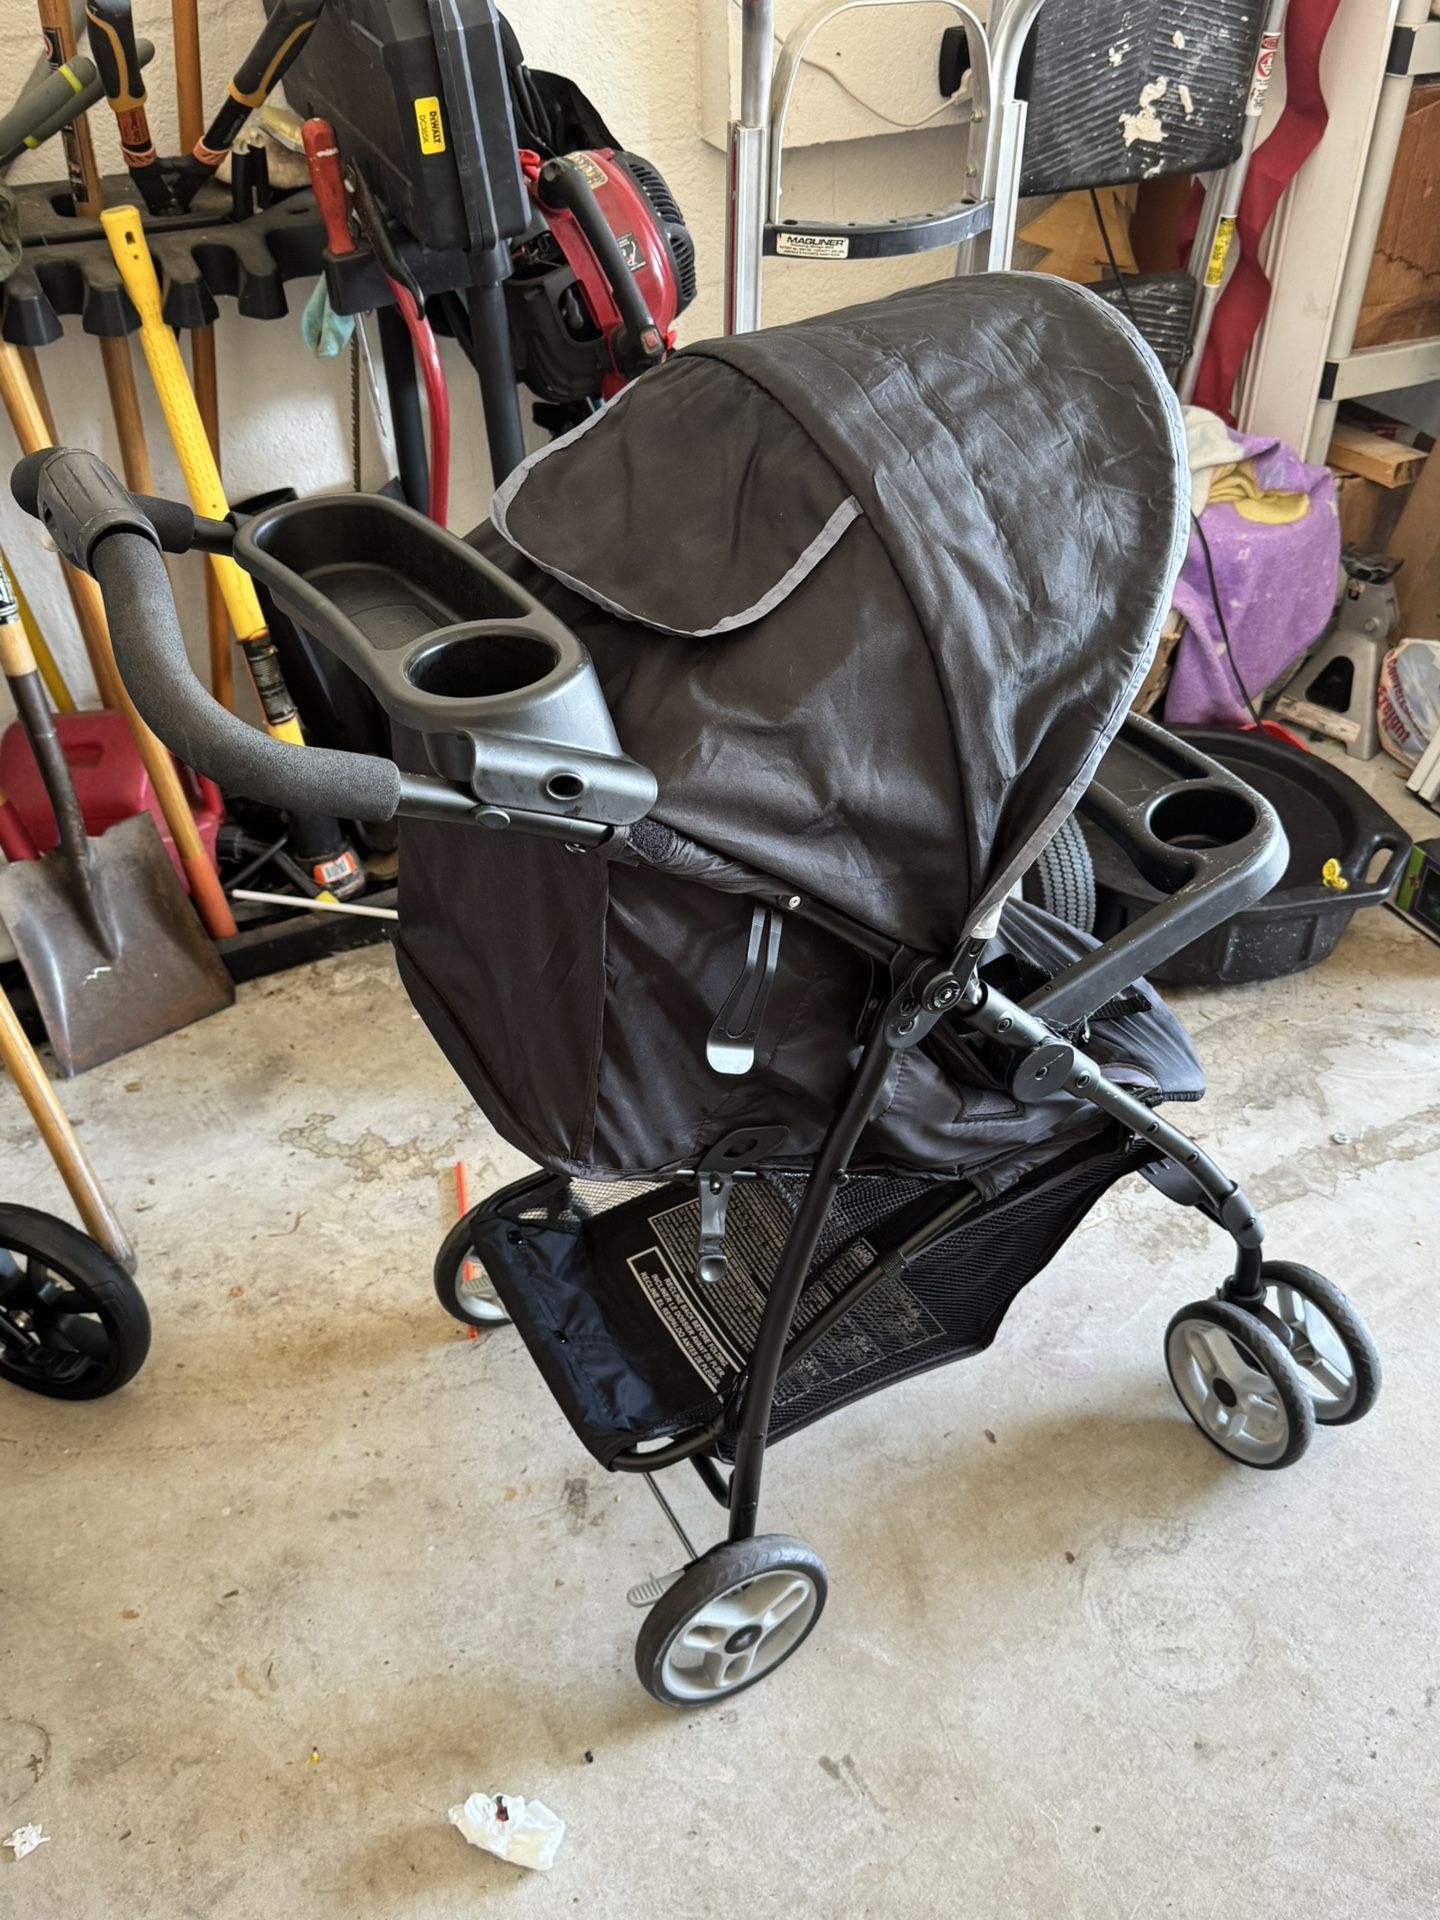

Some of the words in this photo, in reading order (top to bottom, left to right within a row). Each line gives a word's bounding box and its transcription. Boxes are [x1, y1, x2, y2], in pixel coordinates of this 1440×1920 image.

[787, 236, 844, 246] MAGLINER
[639, 1271, 661, 1300] RECLINE
[655, 1298, 666, 1308] EL
[661, 1306, 685, 1338] RESPALDO
[681, 1336, 699, 1358] ANTES
[694, 1354, 704, 1364] DE
[650, 1273, 673, 1303] INCLINER
[668, 1301, 678, 1312] LE
[674, 1309, 694, 1336] DOSSIER
[691, 1334, 708, 1355] AVANT
[703, 1351, 714, 1362] DE
[663, 1277, 684, 1305] RECLINE
[680, 1303, 696, 1321] BACK
[691, 1319, 712, 1345] BEFORE
